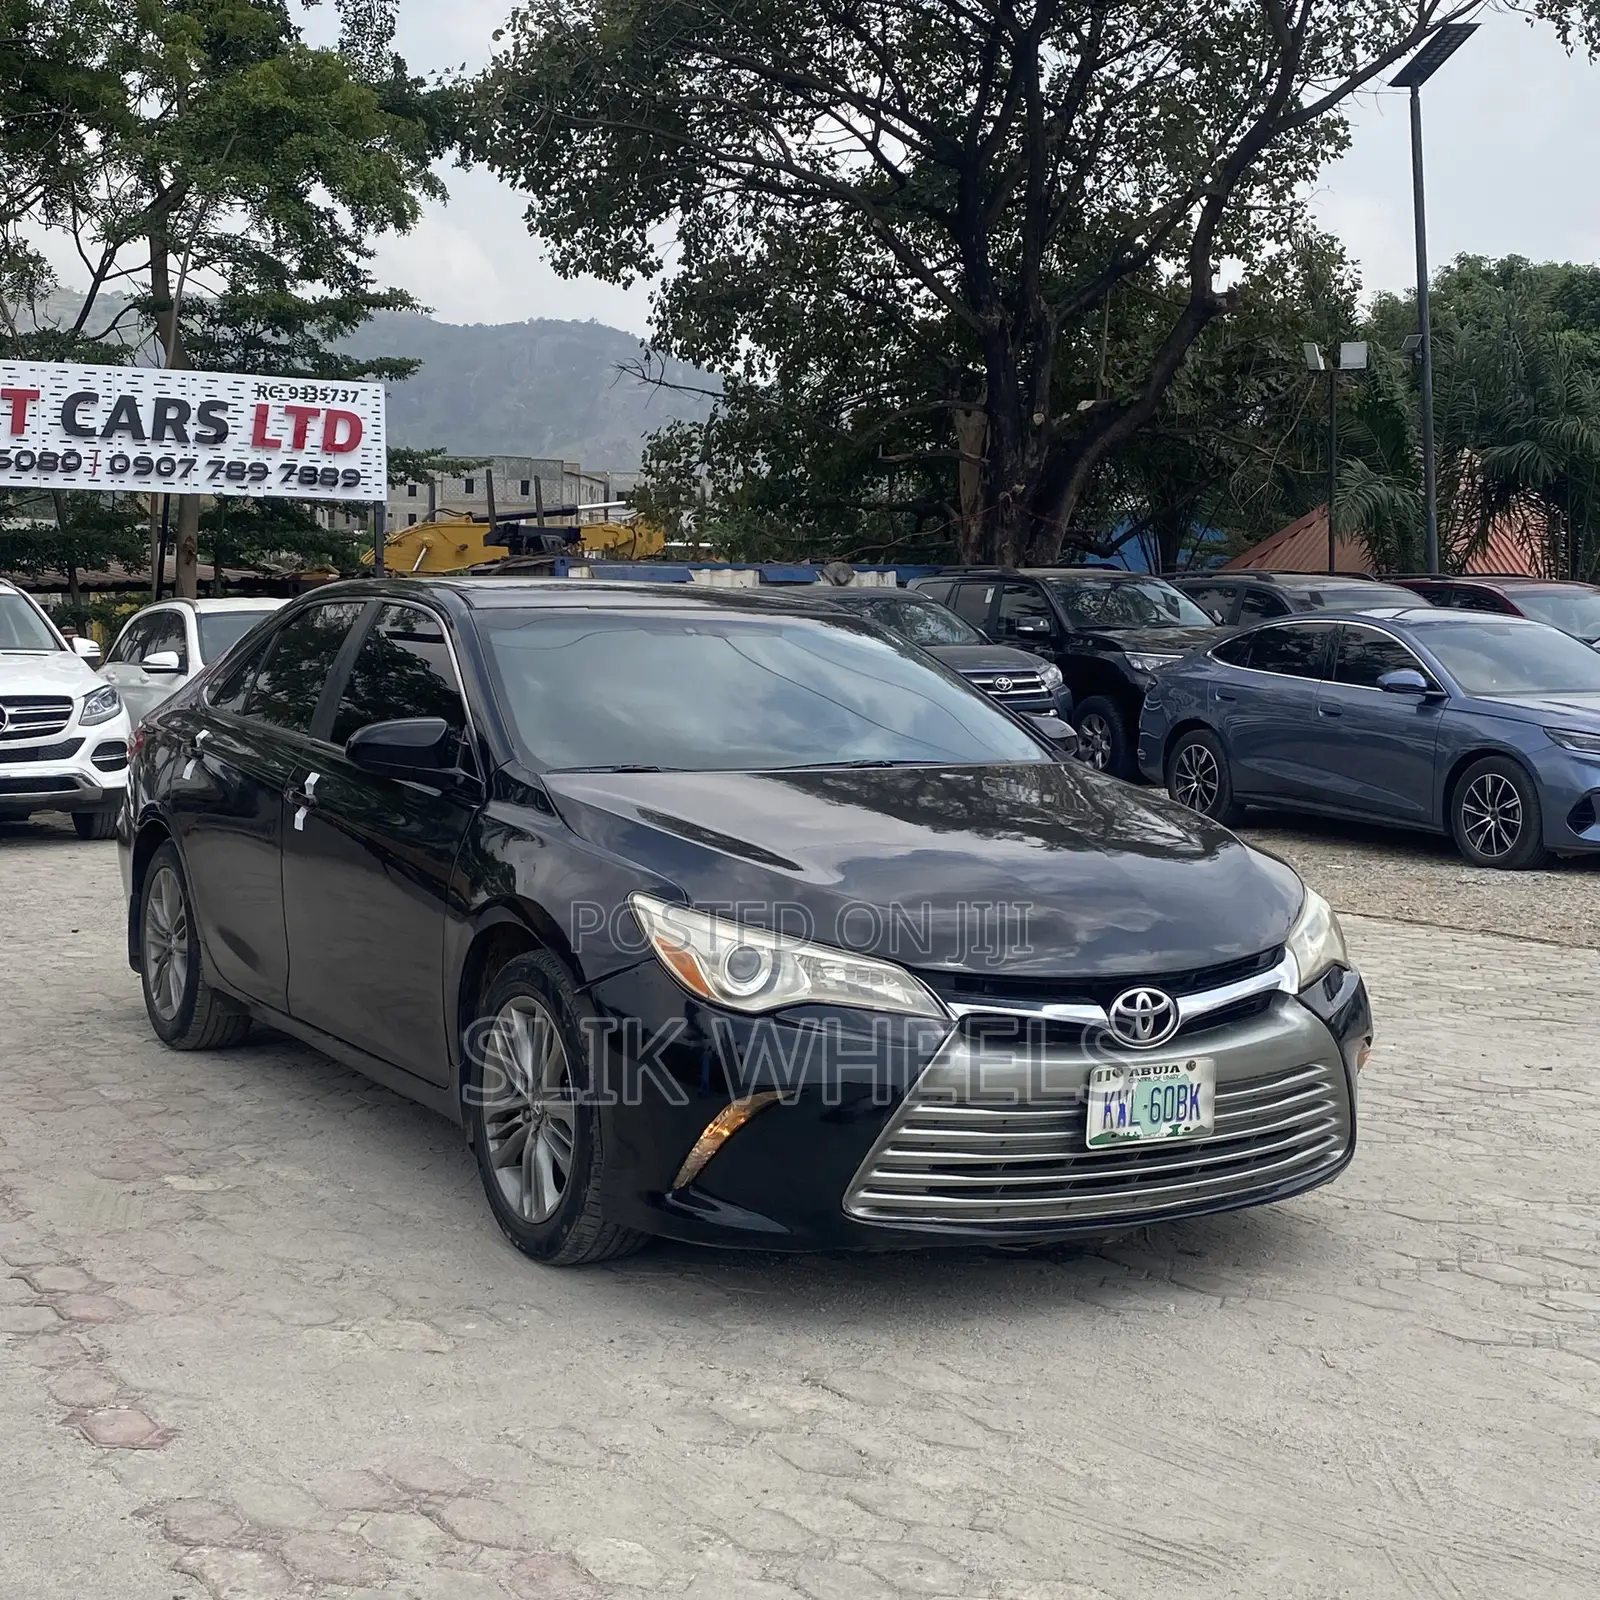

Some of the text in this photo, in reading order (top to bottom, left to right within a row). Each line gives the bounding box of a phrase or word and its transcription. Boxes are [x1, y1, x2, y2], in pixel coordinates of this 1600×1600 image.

[288, 386, 359, 403] 9335737
[61, 391, 229, 444] CARS
[251, 403, 363, 453] LTD
[109, 453, 197, 478] 0907
[205, 459, 269, 482] 789
[278, 463, 361, 487] 7889
[1129, 1065, 1180, 1077] ABUJA
